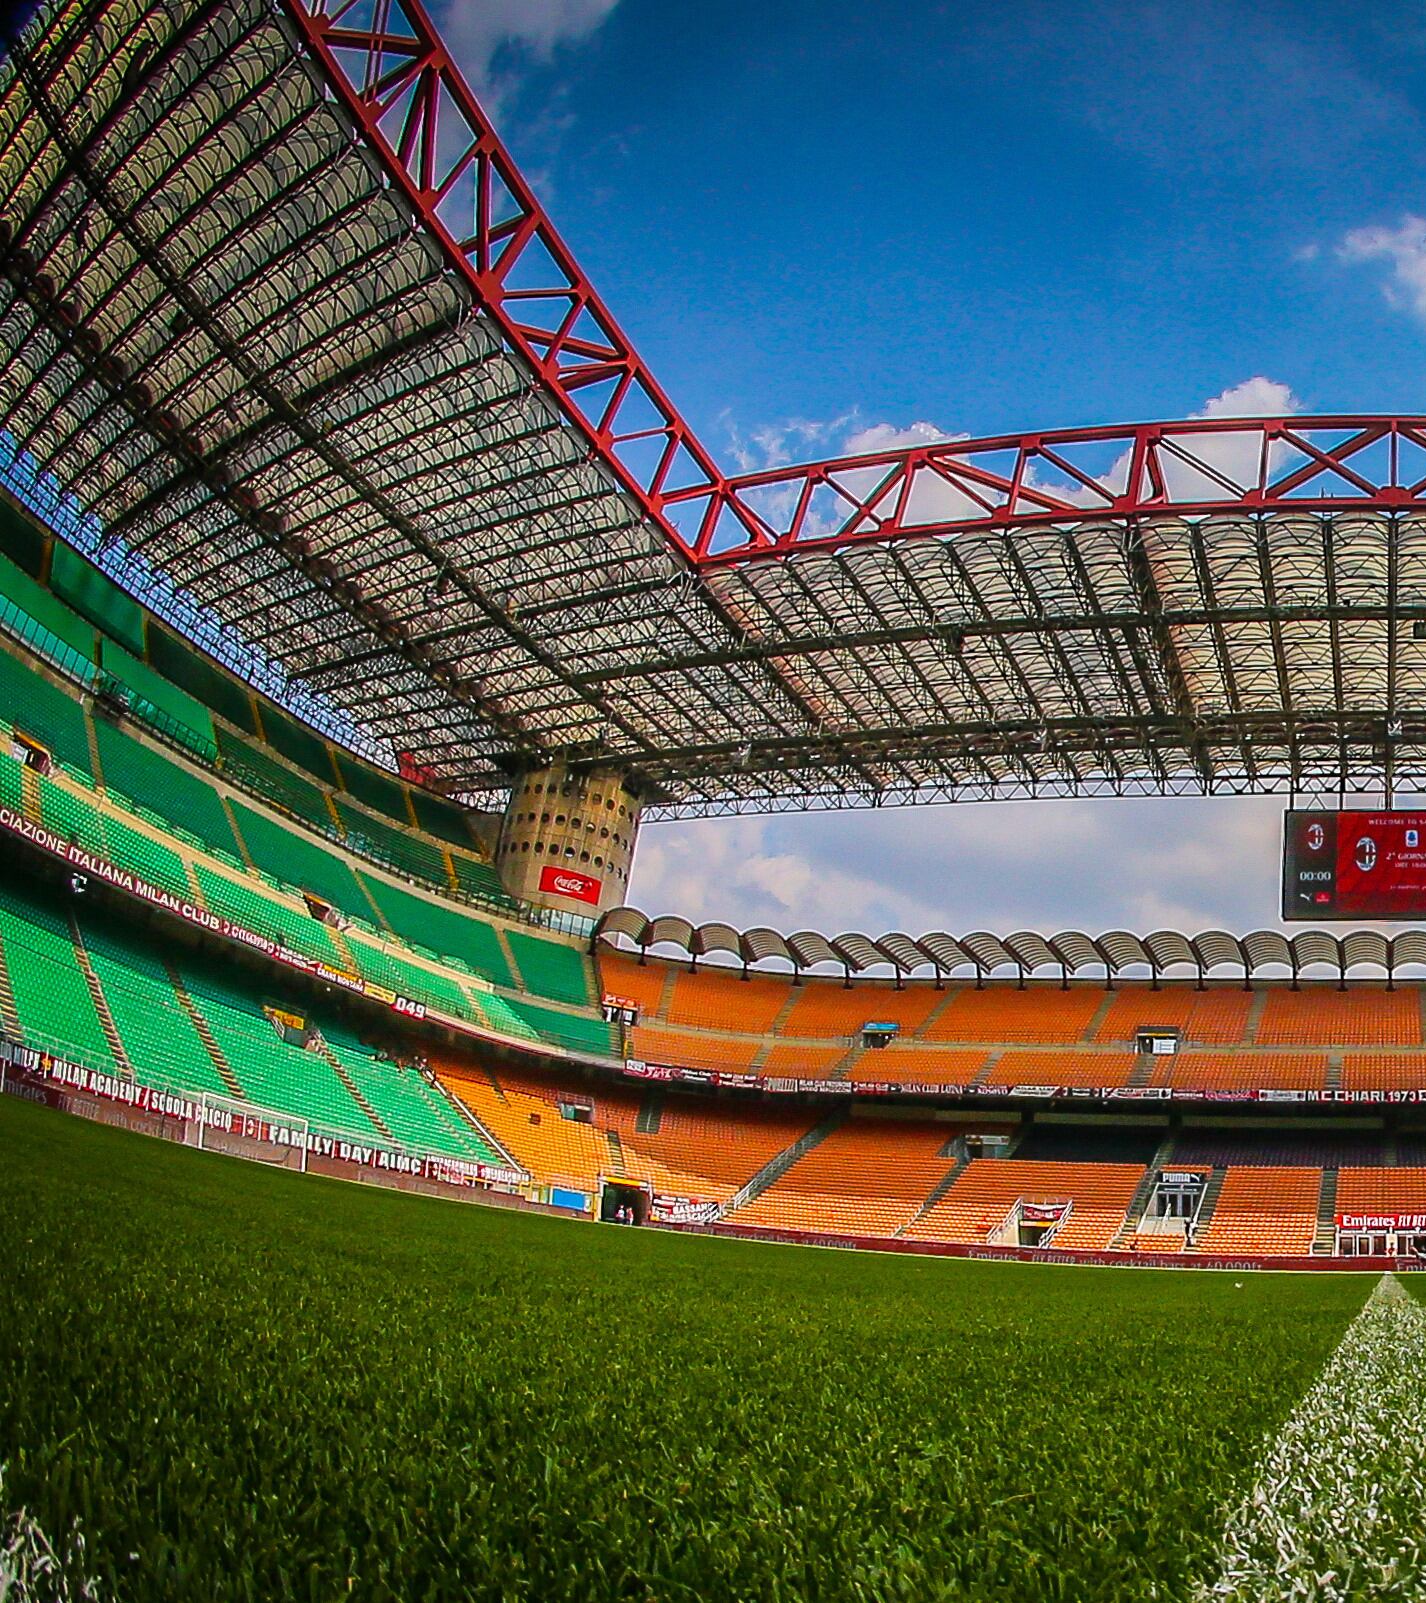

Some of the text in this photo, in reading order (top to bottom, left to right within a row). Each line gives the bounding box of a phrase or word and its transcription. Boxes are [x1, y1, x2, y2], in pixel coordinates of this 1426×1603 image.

[1300, 872, 1331, 880] 00:00
[68, 846, 133, 890] ITALIANA
[135, 881, 179, 912] MILAN
[182, 904, 220, 929] CLUB
[1334, 1091, 1385, 1101] CHIARI
[1387, 1091, 1416, 1101] 1973
[52, 1059, 88, 1088] MILAN
[89, 1072, 142, 1106] ACADEMY
[151, 1092, 193, 1119] SCUOLA
[339, 1142, 372, 1163] DAY
[378, 1151, 421, 1174] AIMC
[1162, 1173, 1190, 1182] PUMA
[1342, 1215, 1396, 1226] Emirates
[1398, 1215, 1411, 1226] FLY
